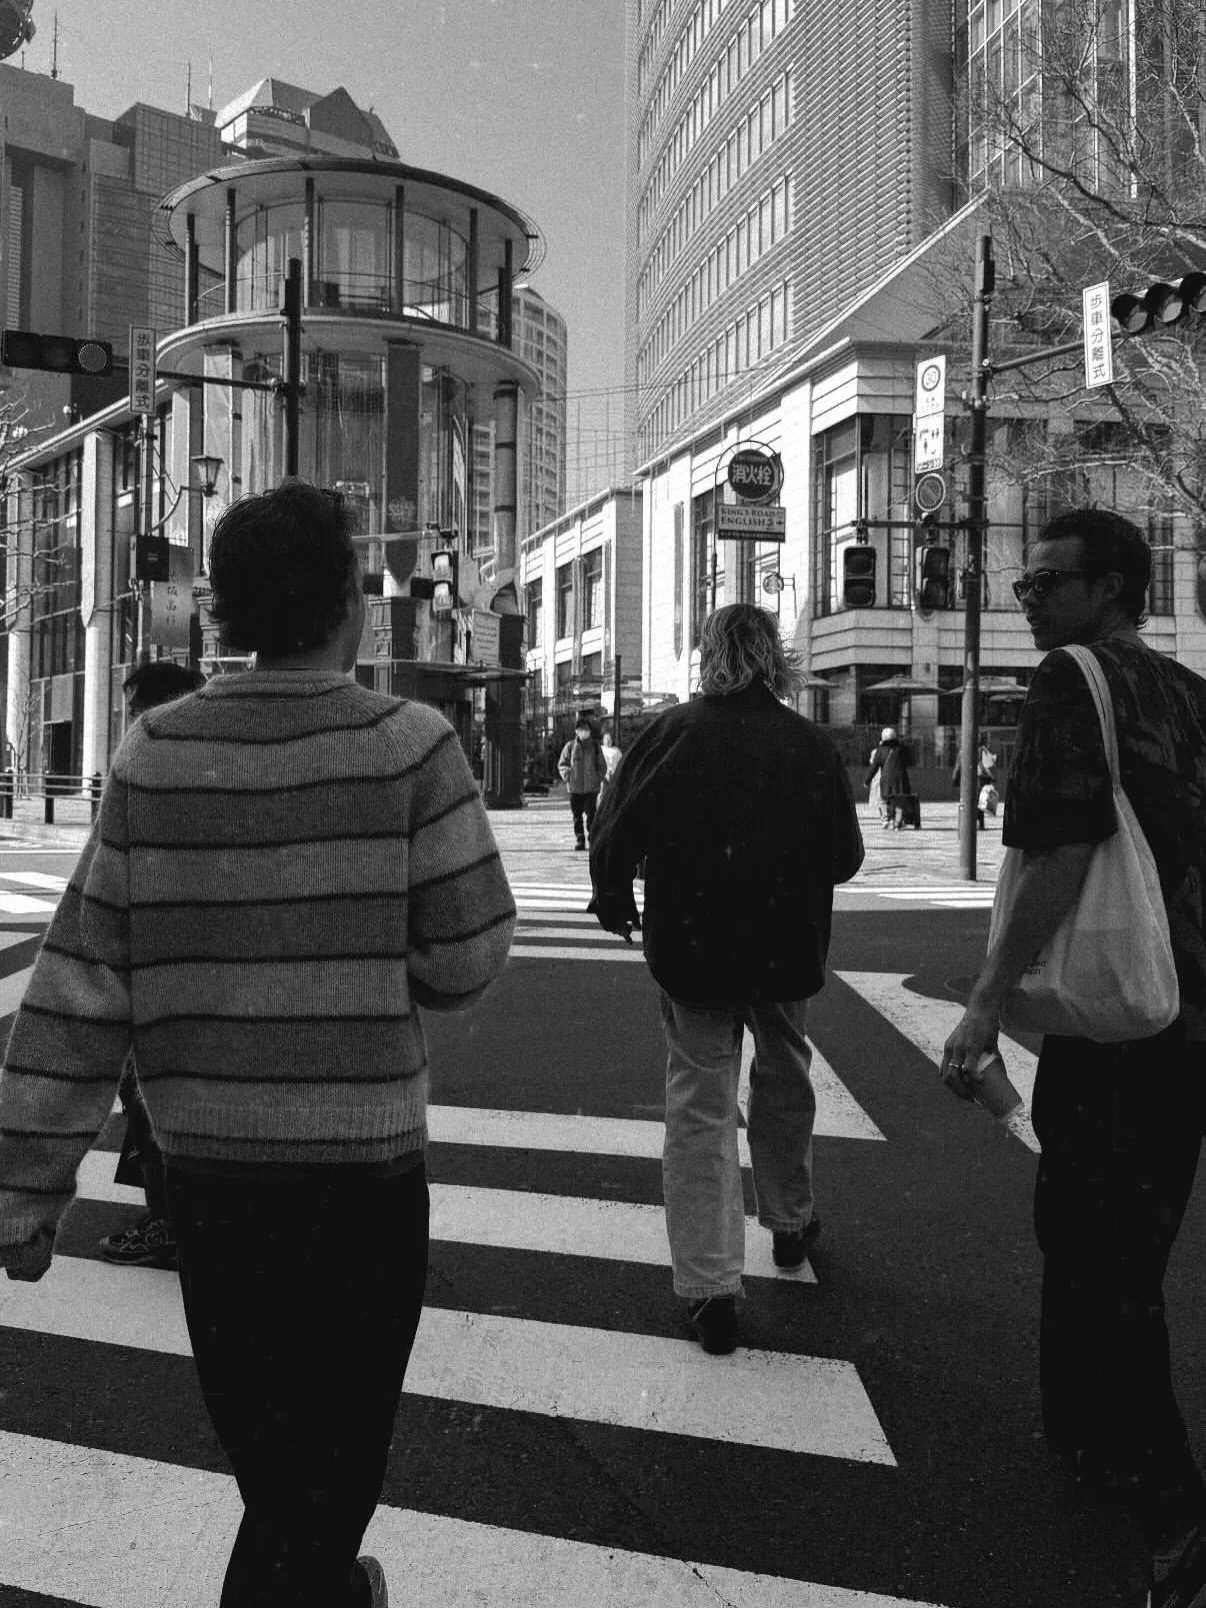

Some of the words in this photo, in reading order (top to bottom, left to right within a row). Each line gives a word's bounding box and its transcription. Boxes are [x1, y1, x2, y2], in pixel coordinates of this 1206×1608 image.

[1090, 293, 1106, 379] 歩車分離式
[135, 333, 151, 409] 歩車分離式
[732, 463, 772, 486] 消火栓
[721, 517, 766, 526] ENGLISH
[751, 510, 775, 518] ROAD
